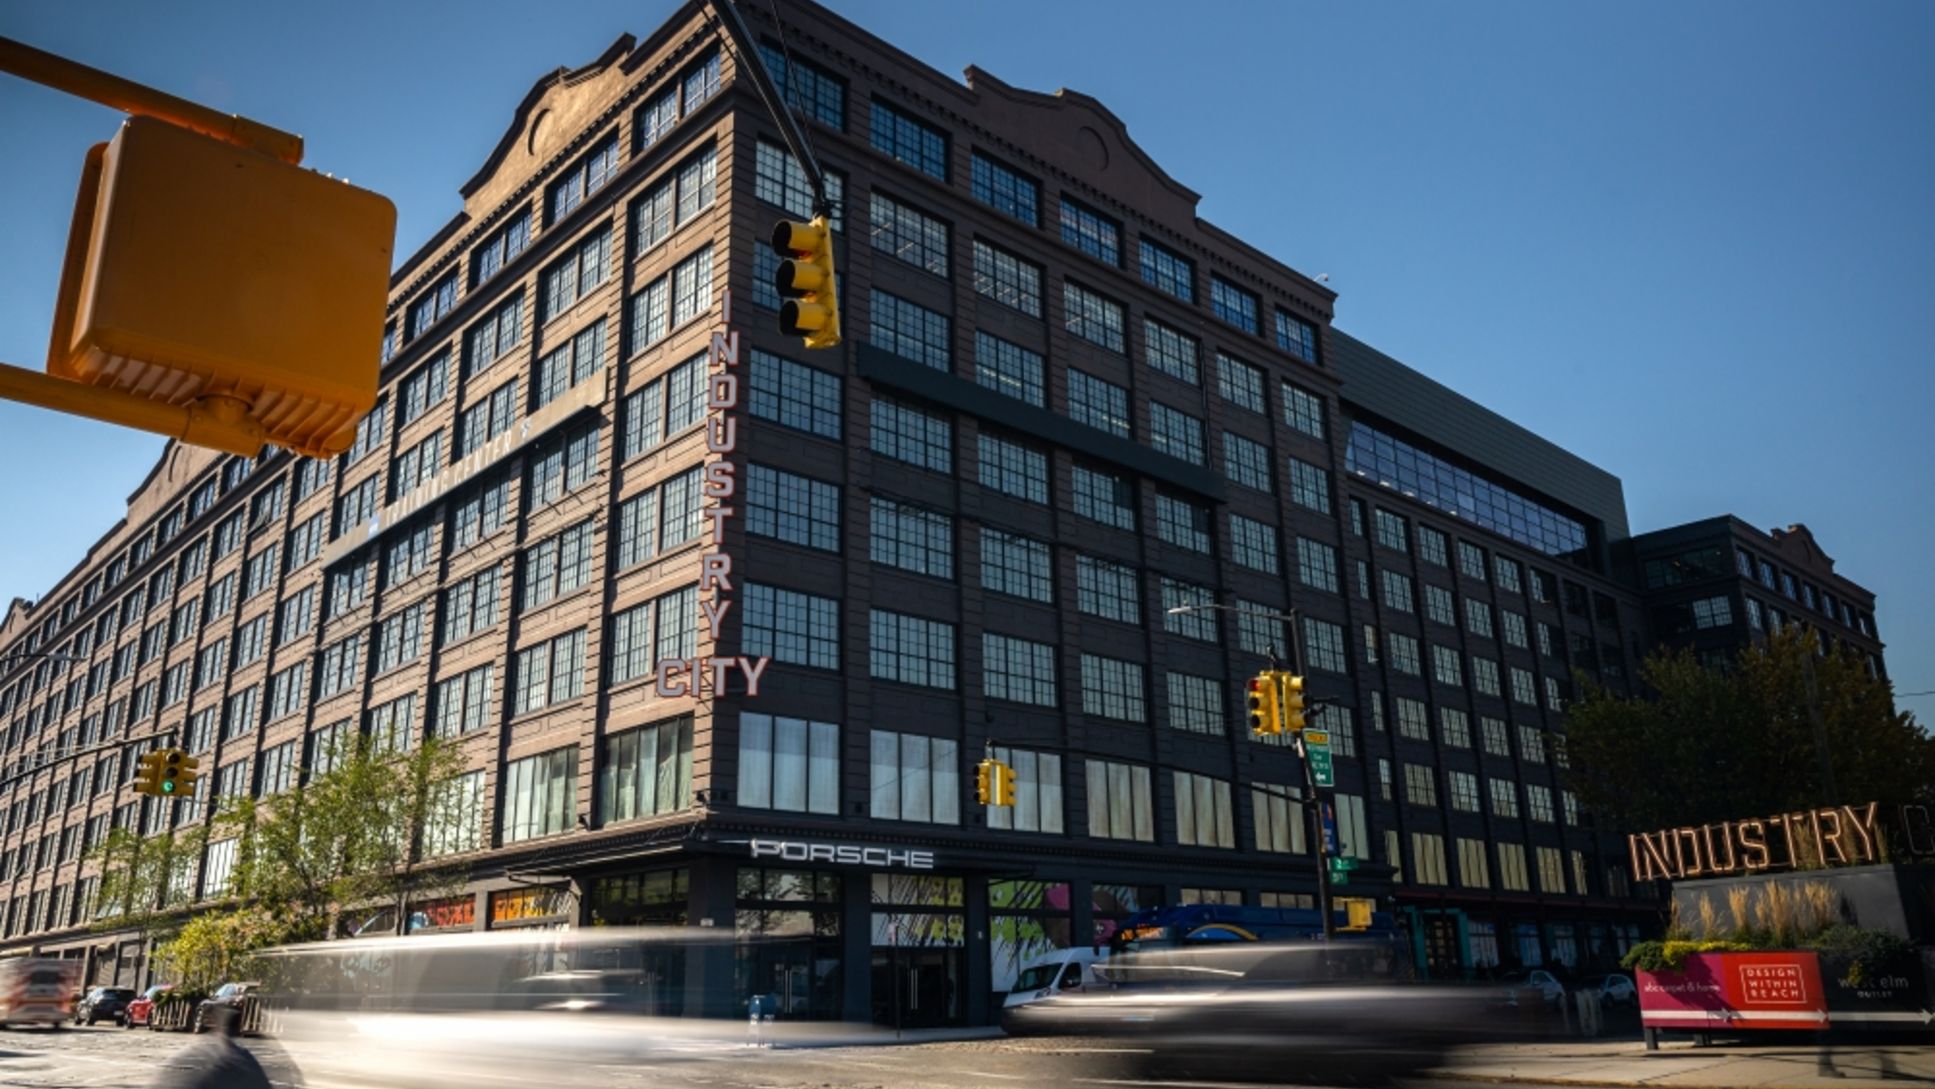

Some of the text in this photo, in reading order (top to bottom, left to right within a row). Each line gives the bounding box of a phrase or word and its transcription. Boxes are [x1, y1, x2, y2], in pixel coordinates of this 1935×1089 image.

[454, 430, 511, 486] CENTER
[701, 290, 739, 640] INDUSTRY
[656, 656, 770, 698] CITY
[751, 838, 934, 869] PORSCHE
[1627, 801, 1878, 882] INDUSTRY
[1746, 968, 1797, 978] DESIGN
[1749, 979, 1797, 988] WITHIN
[1880, 974, 1909, 989] elm
[1751, 989, 1799, 998] REACH
